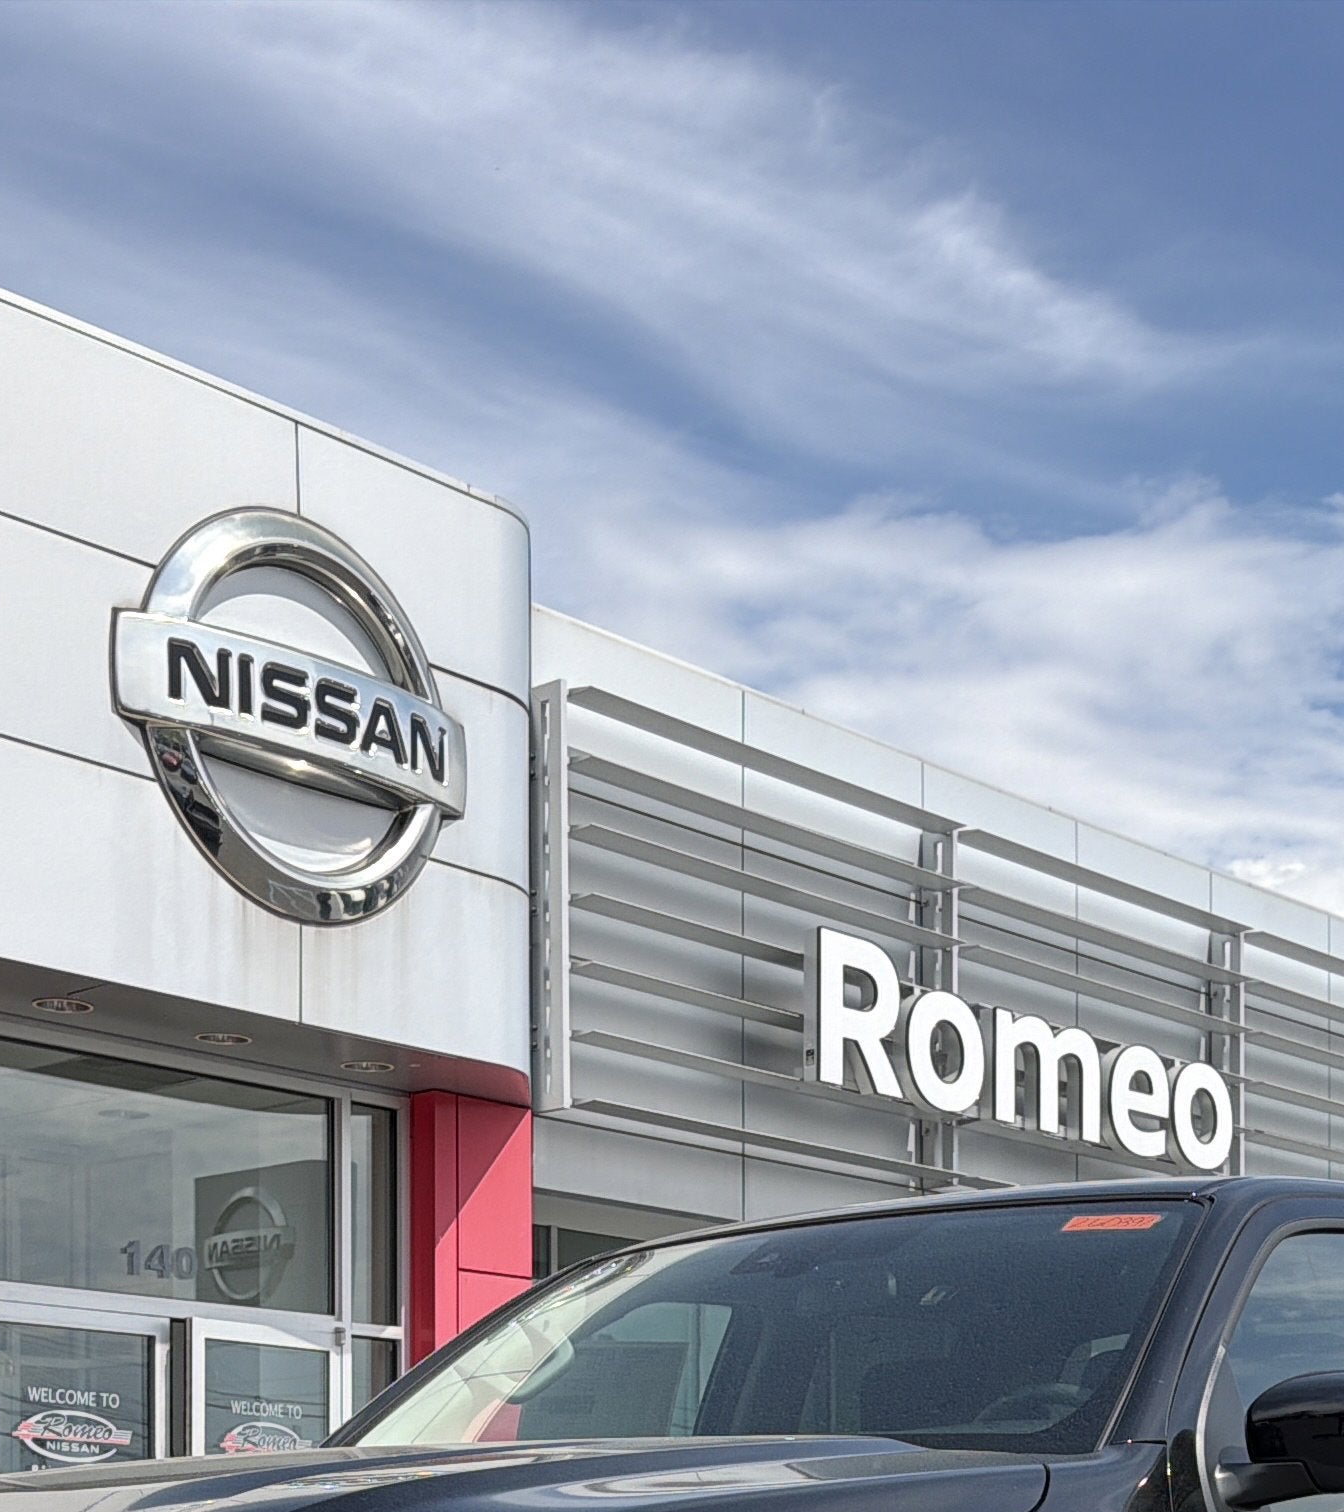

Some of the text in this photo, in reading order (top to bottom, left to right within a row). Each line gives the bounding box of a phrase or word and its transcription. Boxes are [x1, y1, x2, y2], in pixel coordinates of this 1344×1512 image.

[166, 636, 449, 787] NISSAN
[814, 925, 1235, 1171] Romeo
[120, 1240, 198, 1280] 140
[27, 1385, 120, 1409] WELCOME TO
[230, 1399, 303, 1420] WELCOME TO
[35, 1412, 113, 1441] Romeo
[46, 1440, 100, 1454] NISSAN
